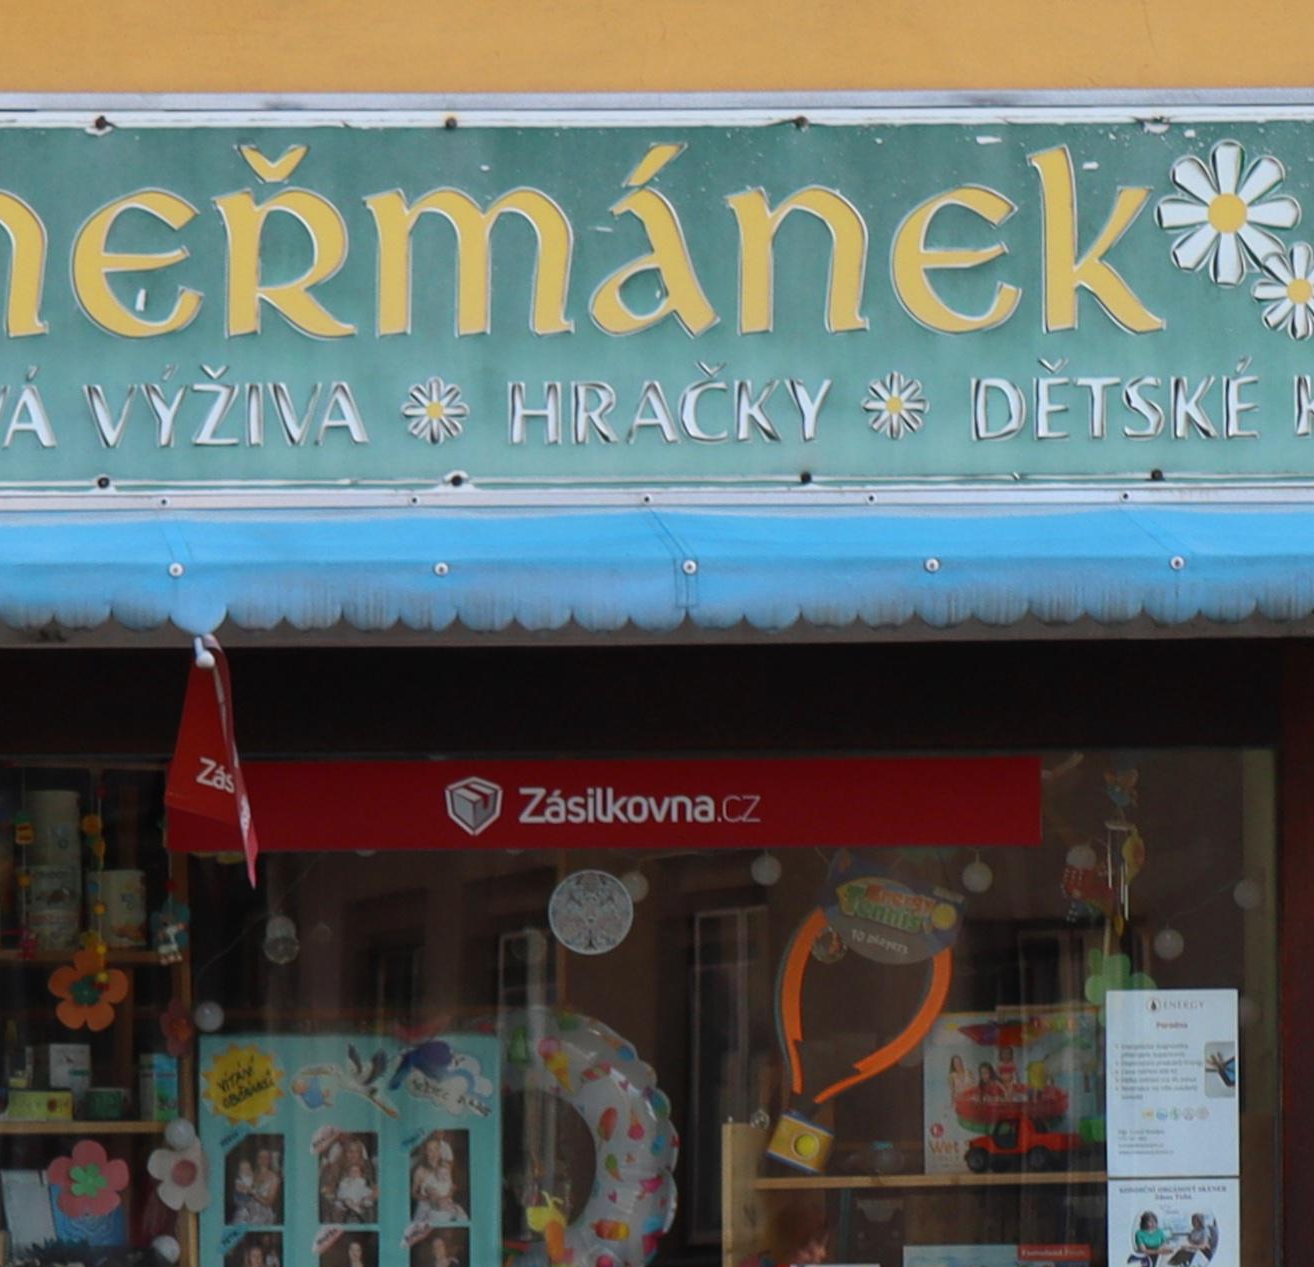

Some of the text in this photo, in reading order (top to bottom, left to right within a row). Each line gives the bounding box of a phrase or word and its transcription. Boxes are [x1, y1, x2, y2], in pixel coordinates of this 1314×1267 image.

[84, 364, 368, 447] VÝŽIVA
[507, 361, 832, 446] HRAČKY
[970, 356, 1261, 442] DĚTSKÉ
